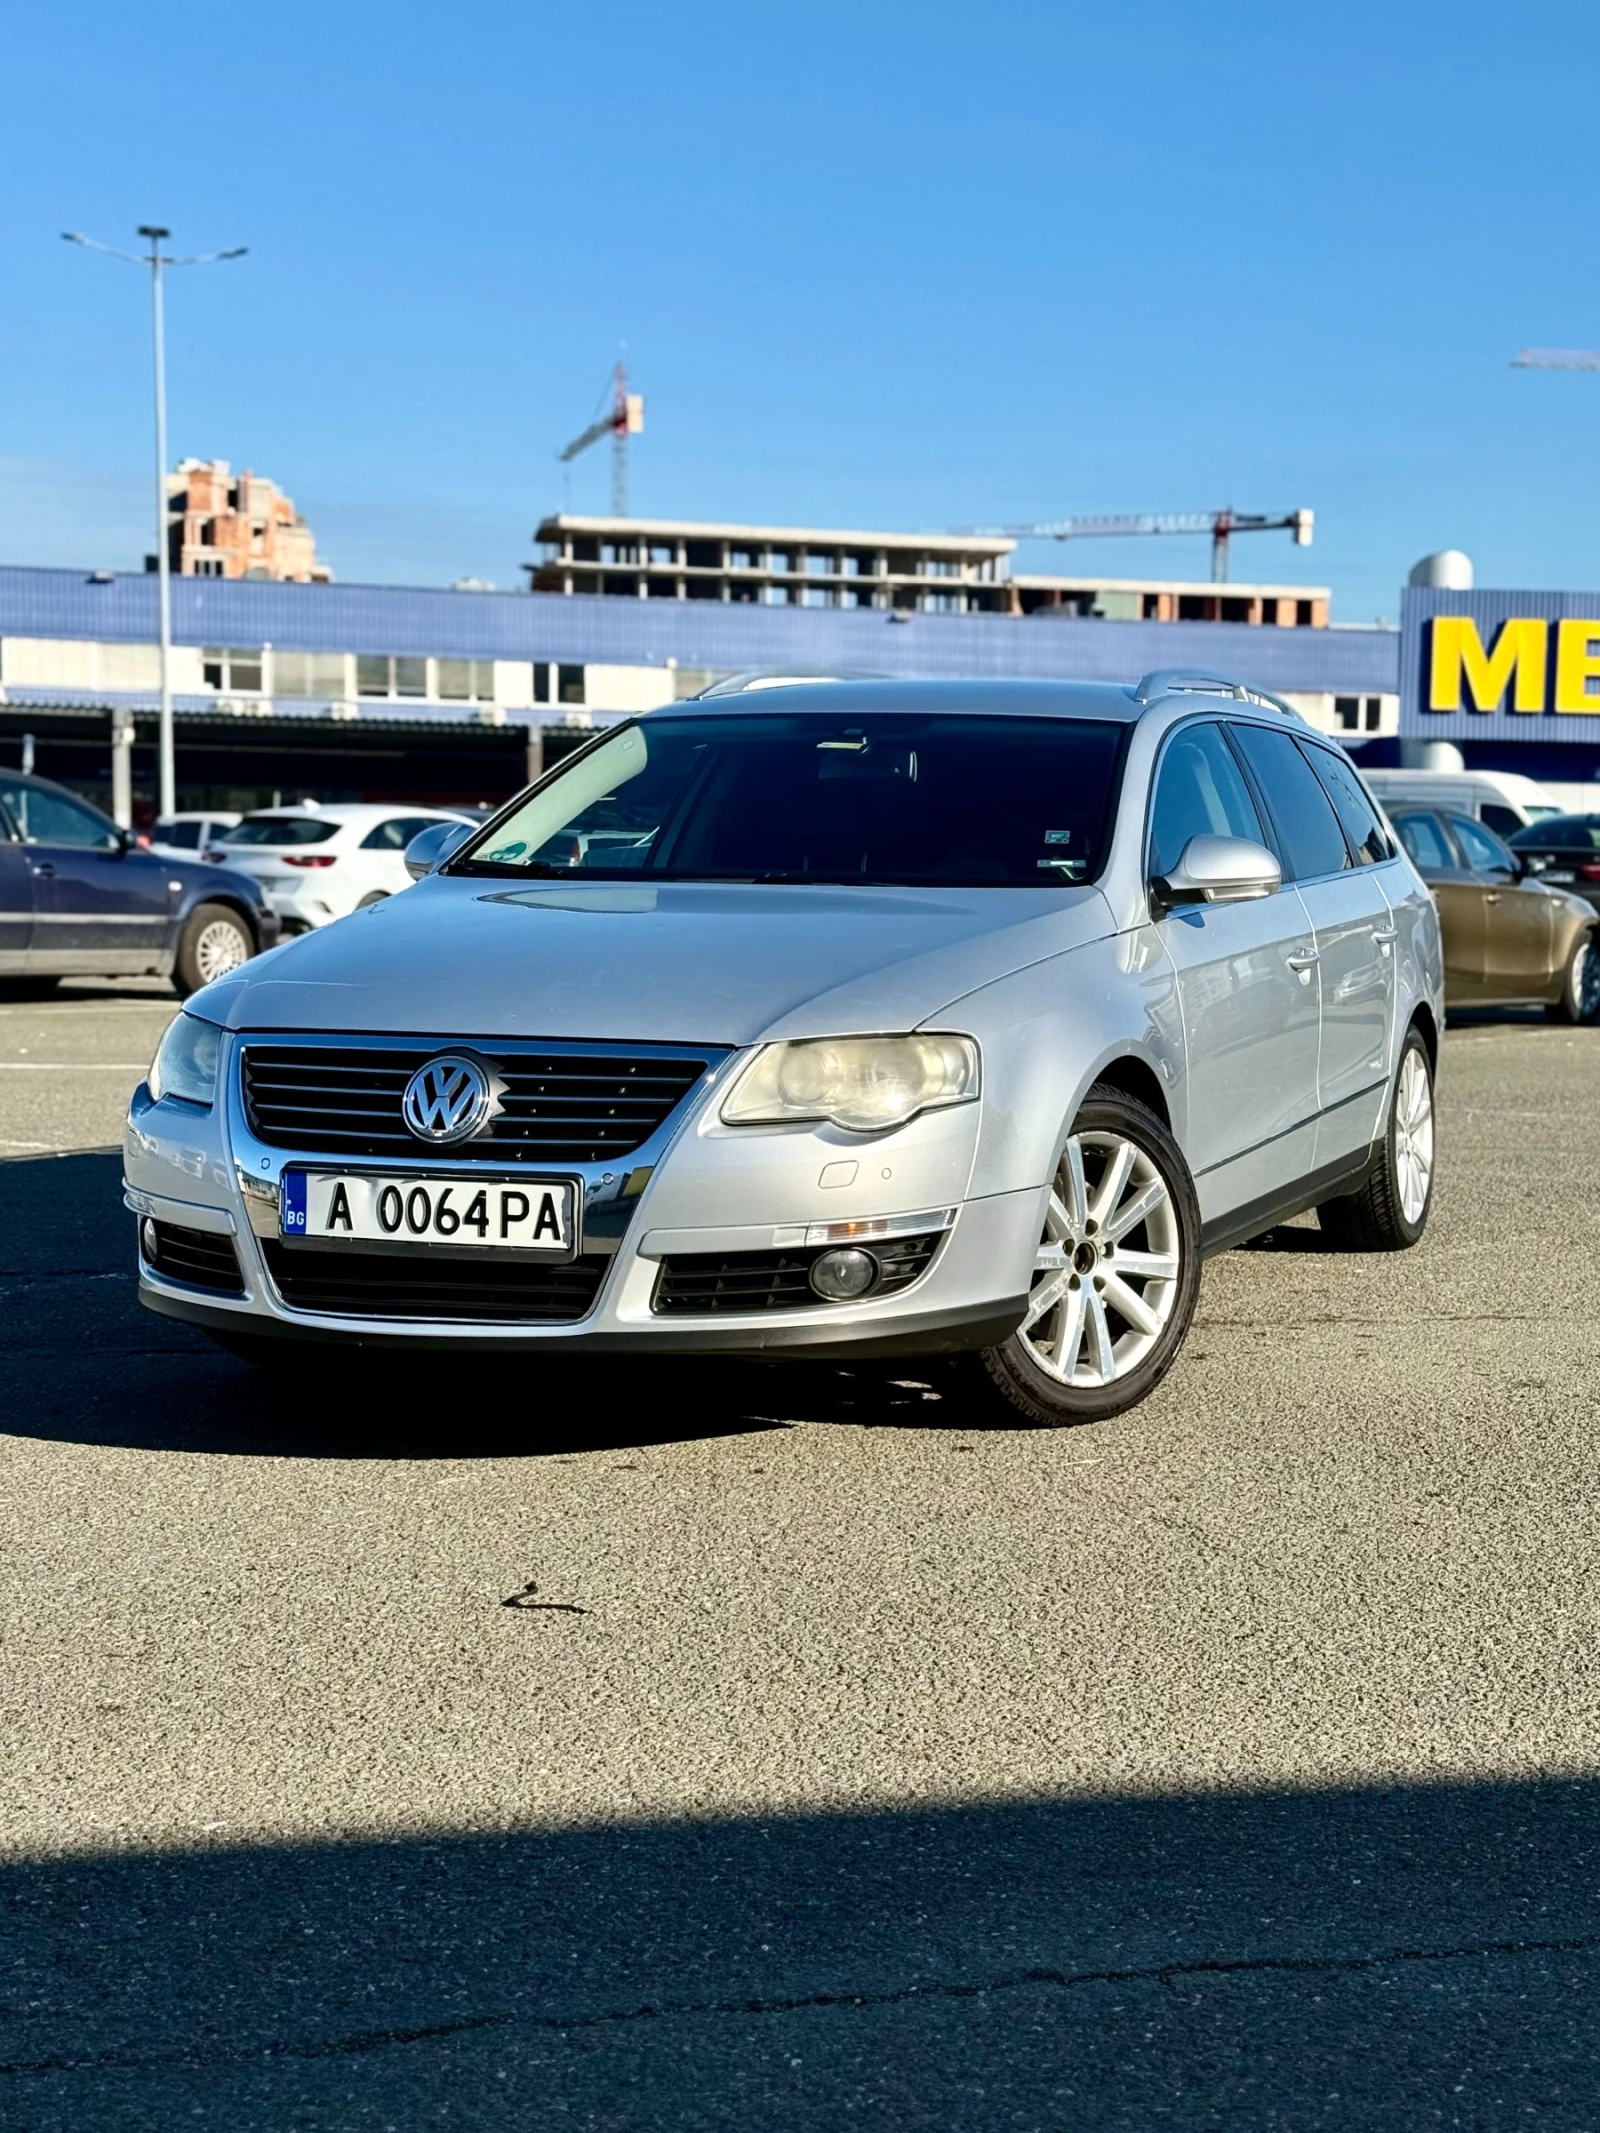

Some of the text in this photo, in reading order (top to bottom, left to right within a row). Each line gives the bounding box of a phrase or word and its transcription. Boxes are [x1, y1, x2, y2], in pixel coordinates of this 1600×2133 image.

[1429, 616, 1600, 714] ME
[286, 1210, 306, 1227] BG
[325, 1181, 355, 1231] A
